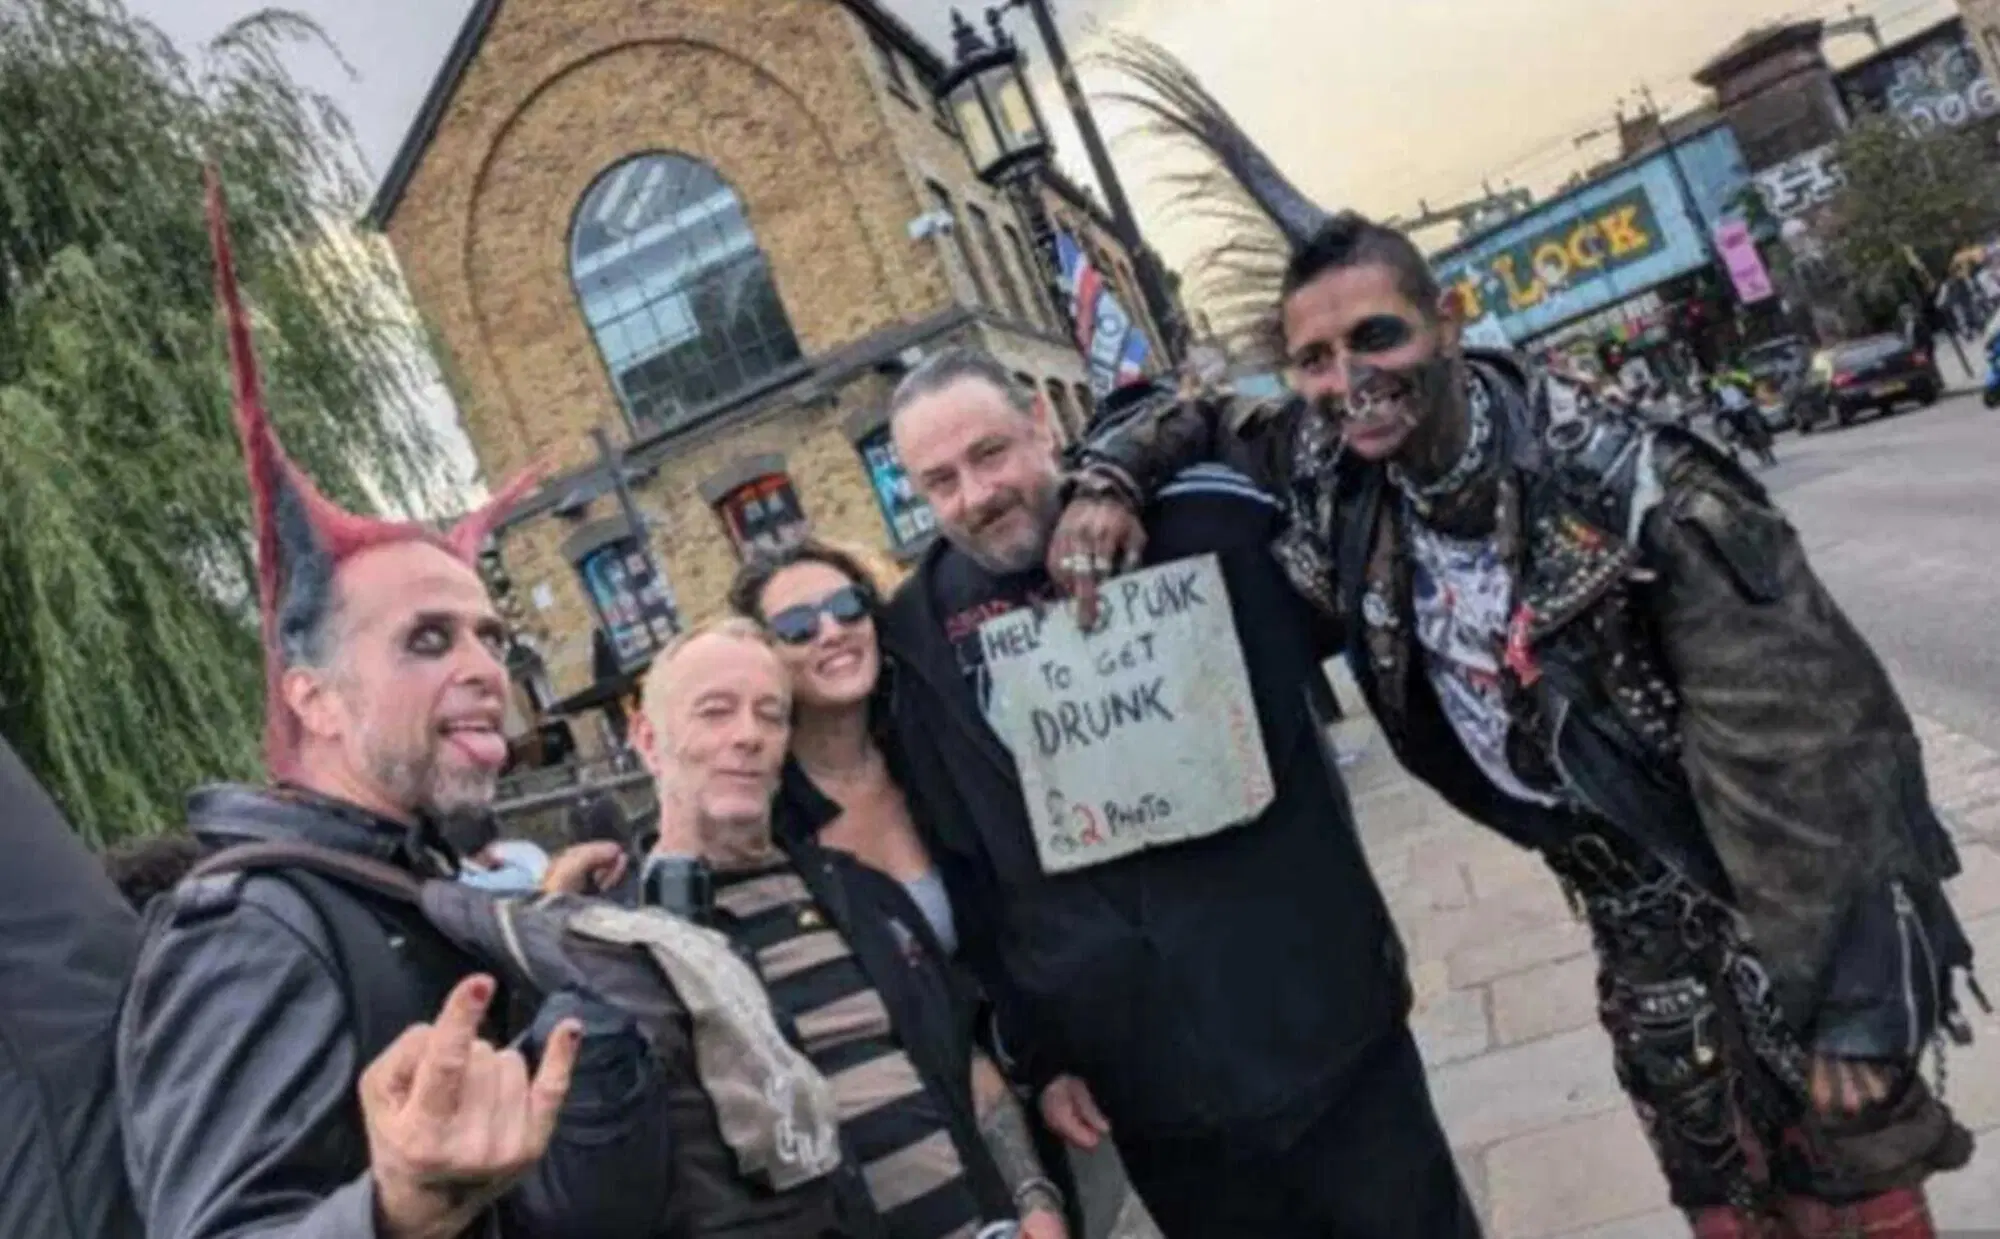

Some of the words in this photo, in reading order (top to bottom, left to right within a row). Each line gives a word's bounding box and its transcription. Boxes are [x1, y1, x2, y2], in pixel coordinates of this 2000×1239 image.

[1491, 205, 1648, 311] LOCK
[1120, 570, 1207, 626] PUNK
[1039, 659, 1071, 691] TO
[1097, 633, 1156, 678] GET
[1030, 676, 1174, 756] DRUNK
